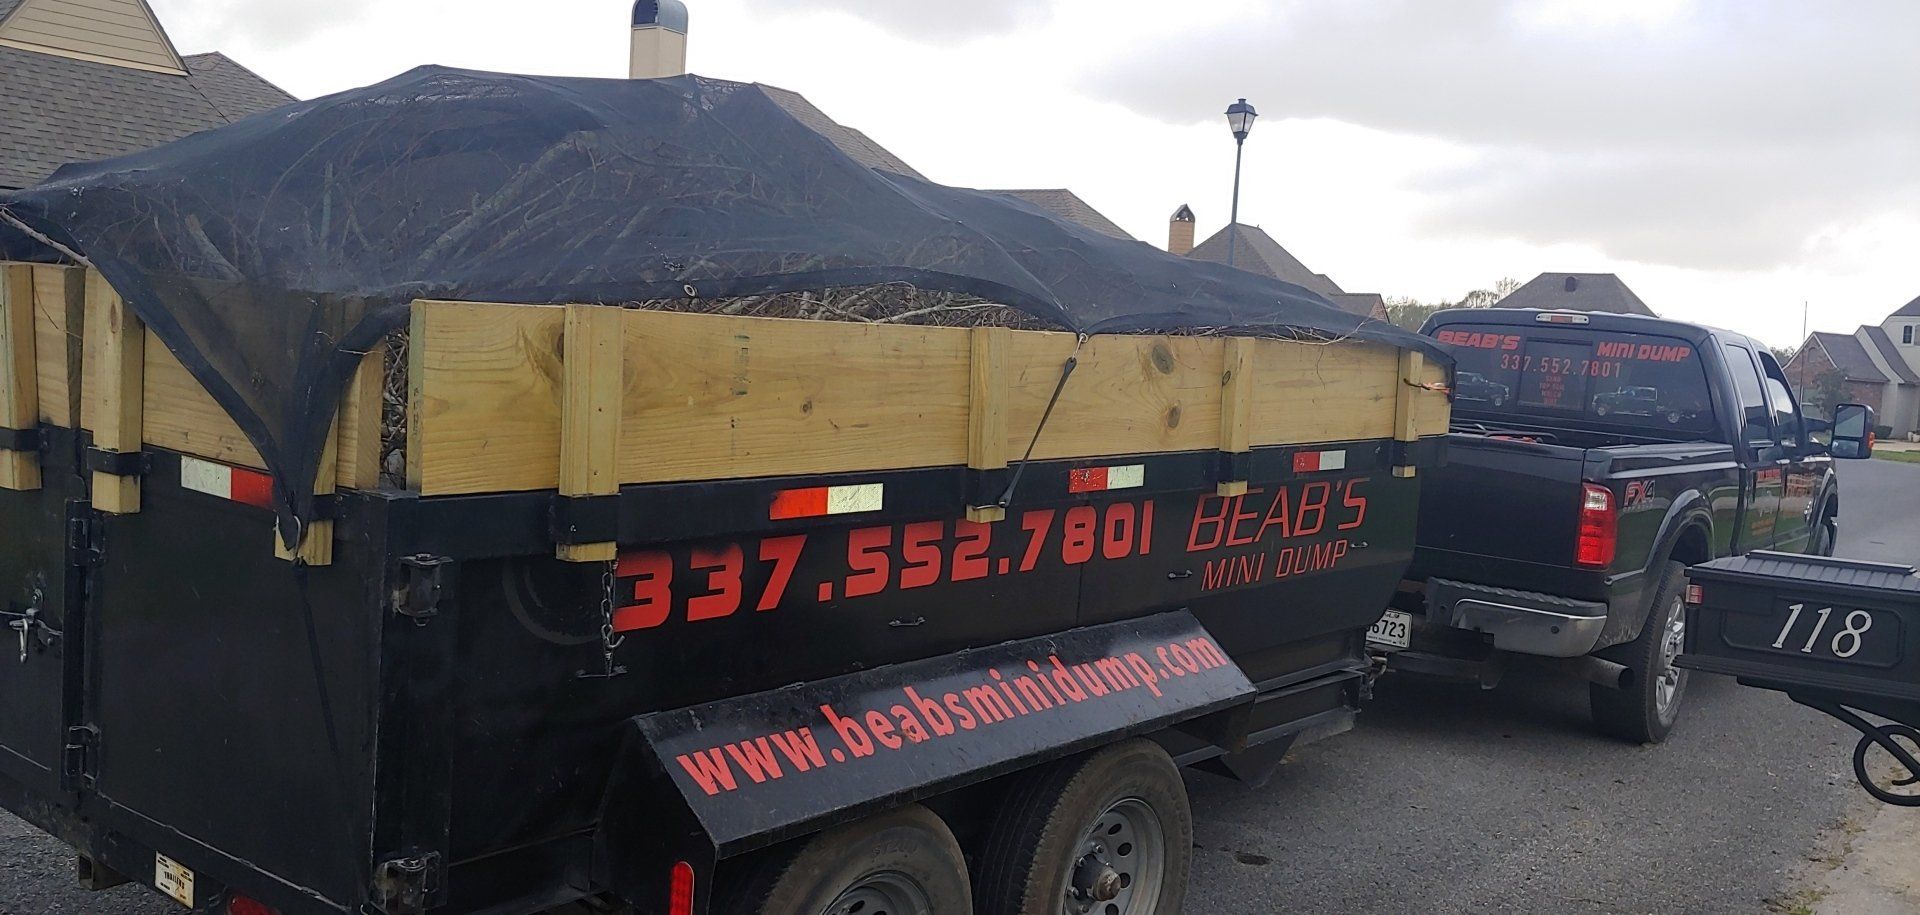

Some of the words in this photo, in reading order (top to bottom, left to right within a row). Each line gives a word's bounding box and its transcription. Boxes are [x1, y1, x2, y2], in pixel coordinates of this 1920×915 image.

[1437, 330, 1520, 351] BEAB'S
[1500, 353, 1622, 378] 337.552.7801
[1596, 341, 1636, 359] MINI
[1637, 344, 1692, 363] DUMP
[1186, 477, 1371, 553] BEAB'S
[1624, 479, 1656, 507] FX4
[613, 499, 1155, 633] 337.552.7801
[1200, 551, 1266, 592] MINI
[1275, 539, 1349, 578] DUMP
[1771, 603, 1873, 659] 118
[676, 635, 1229, 797] www.beabsminidump.com
